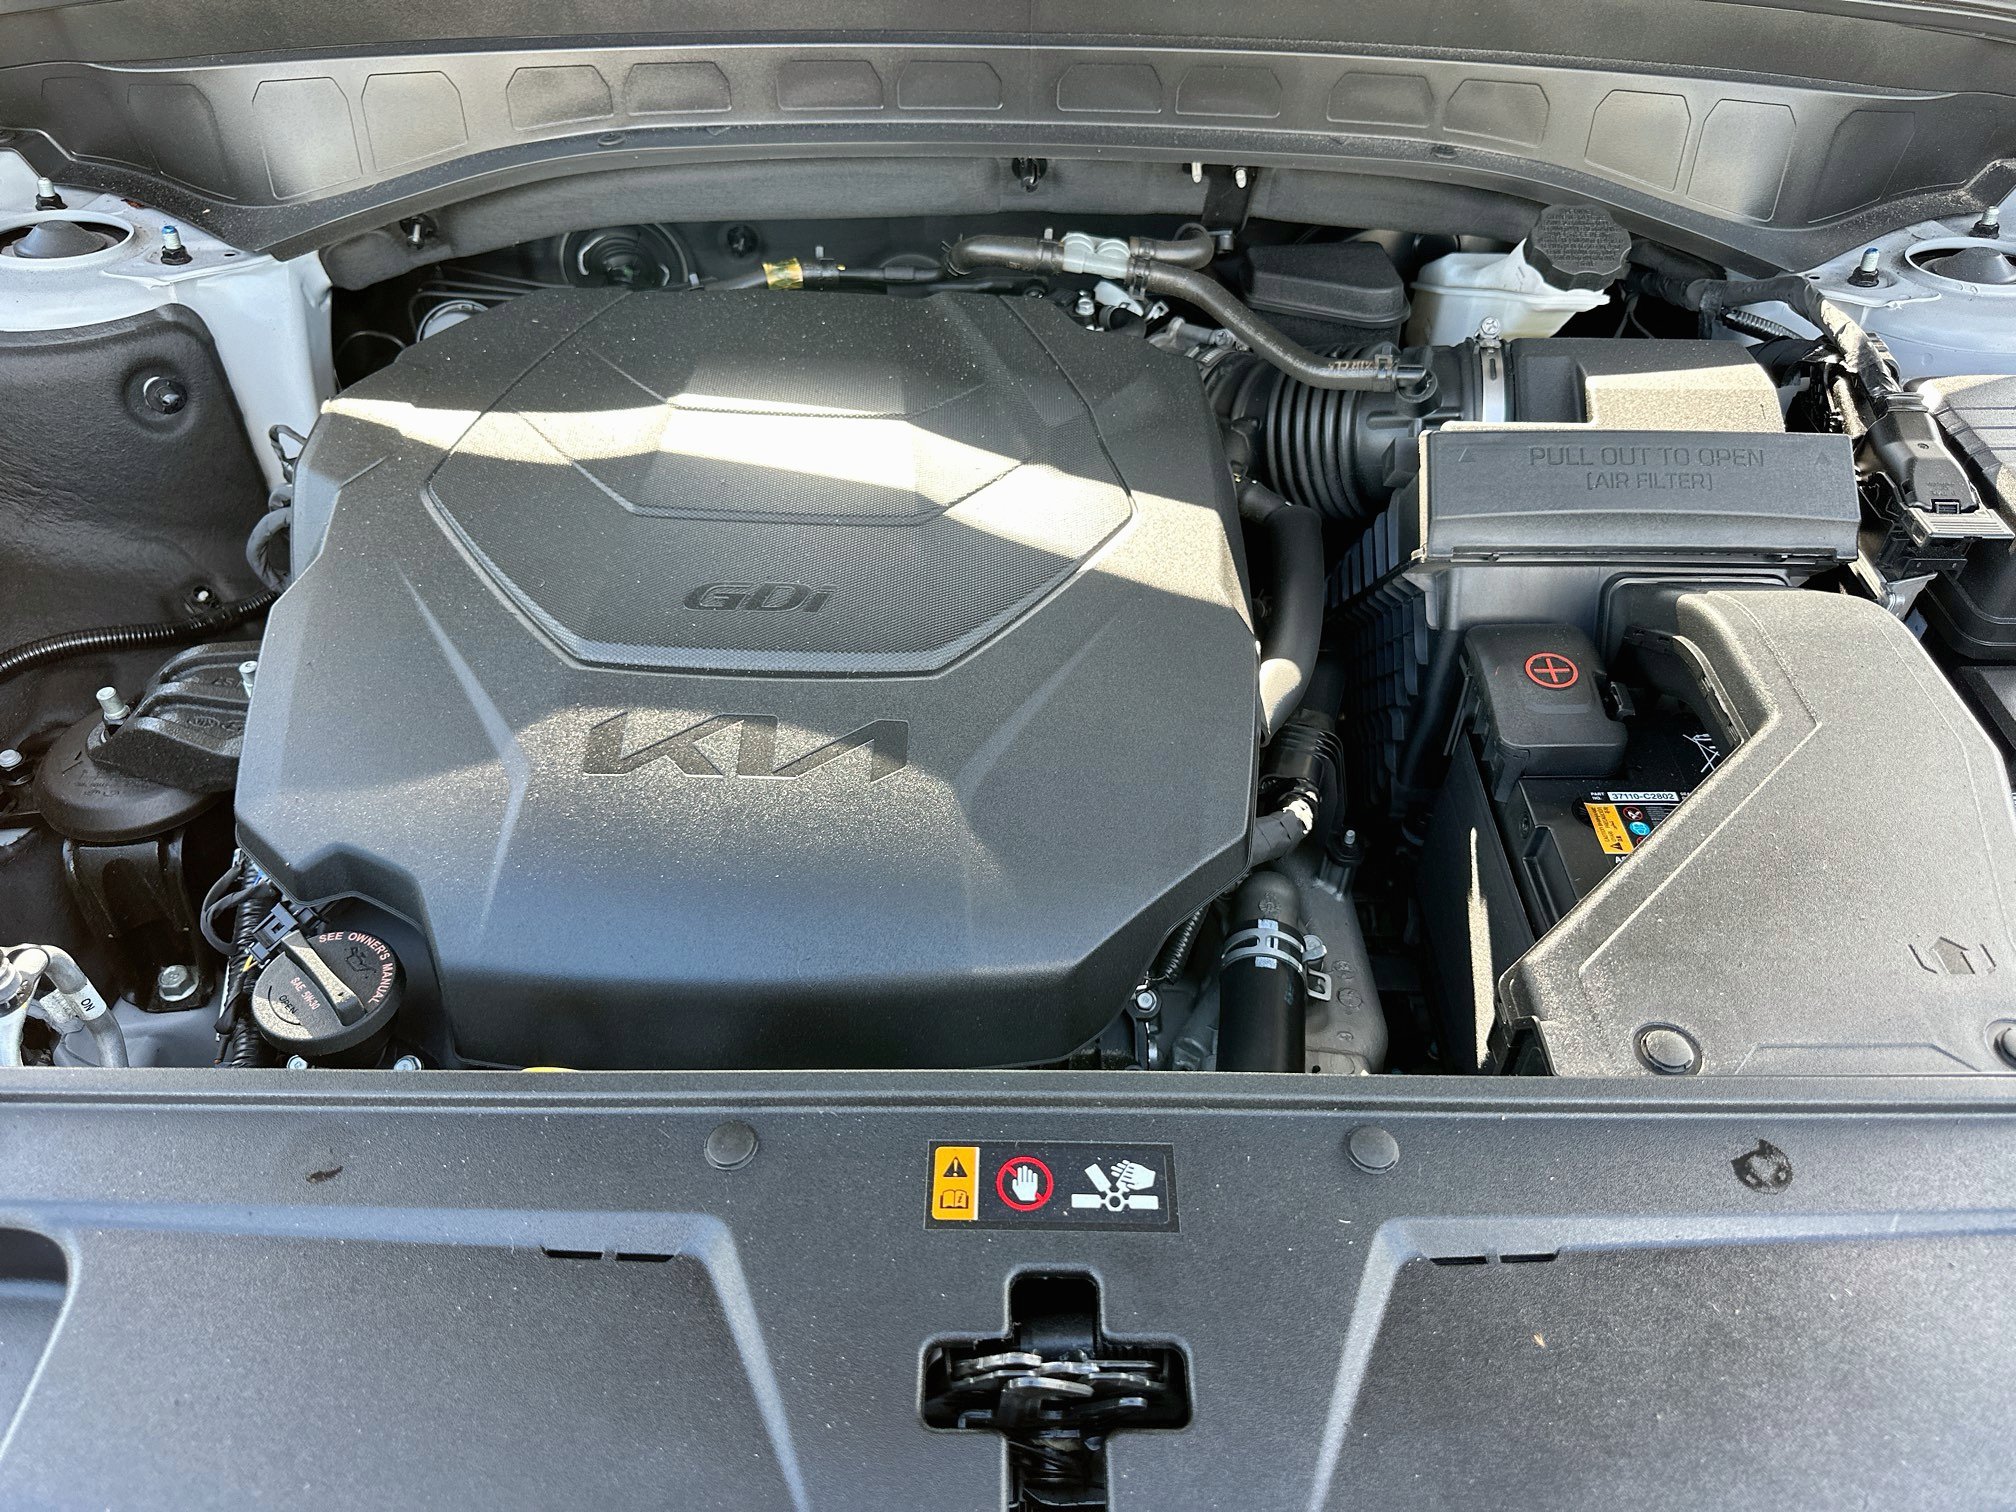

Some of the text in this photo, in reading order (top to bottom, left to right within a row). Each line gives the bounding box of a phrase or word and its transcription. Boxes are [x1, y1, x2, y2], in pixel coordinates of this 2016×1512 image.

[1529, 446, 1764, 467] PULL OUT TO OPEN
[583, 711, 909, 784] KIA
[1611, 792, 1675, 800] 37110-C2802
[319, 931, 394, 1003] SEE OWNER'S MANUAL
[279, 994, 299, 1014] OPEN
[290, 976, 321, 1010] SAE 5W-30
